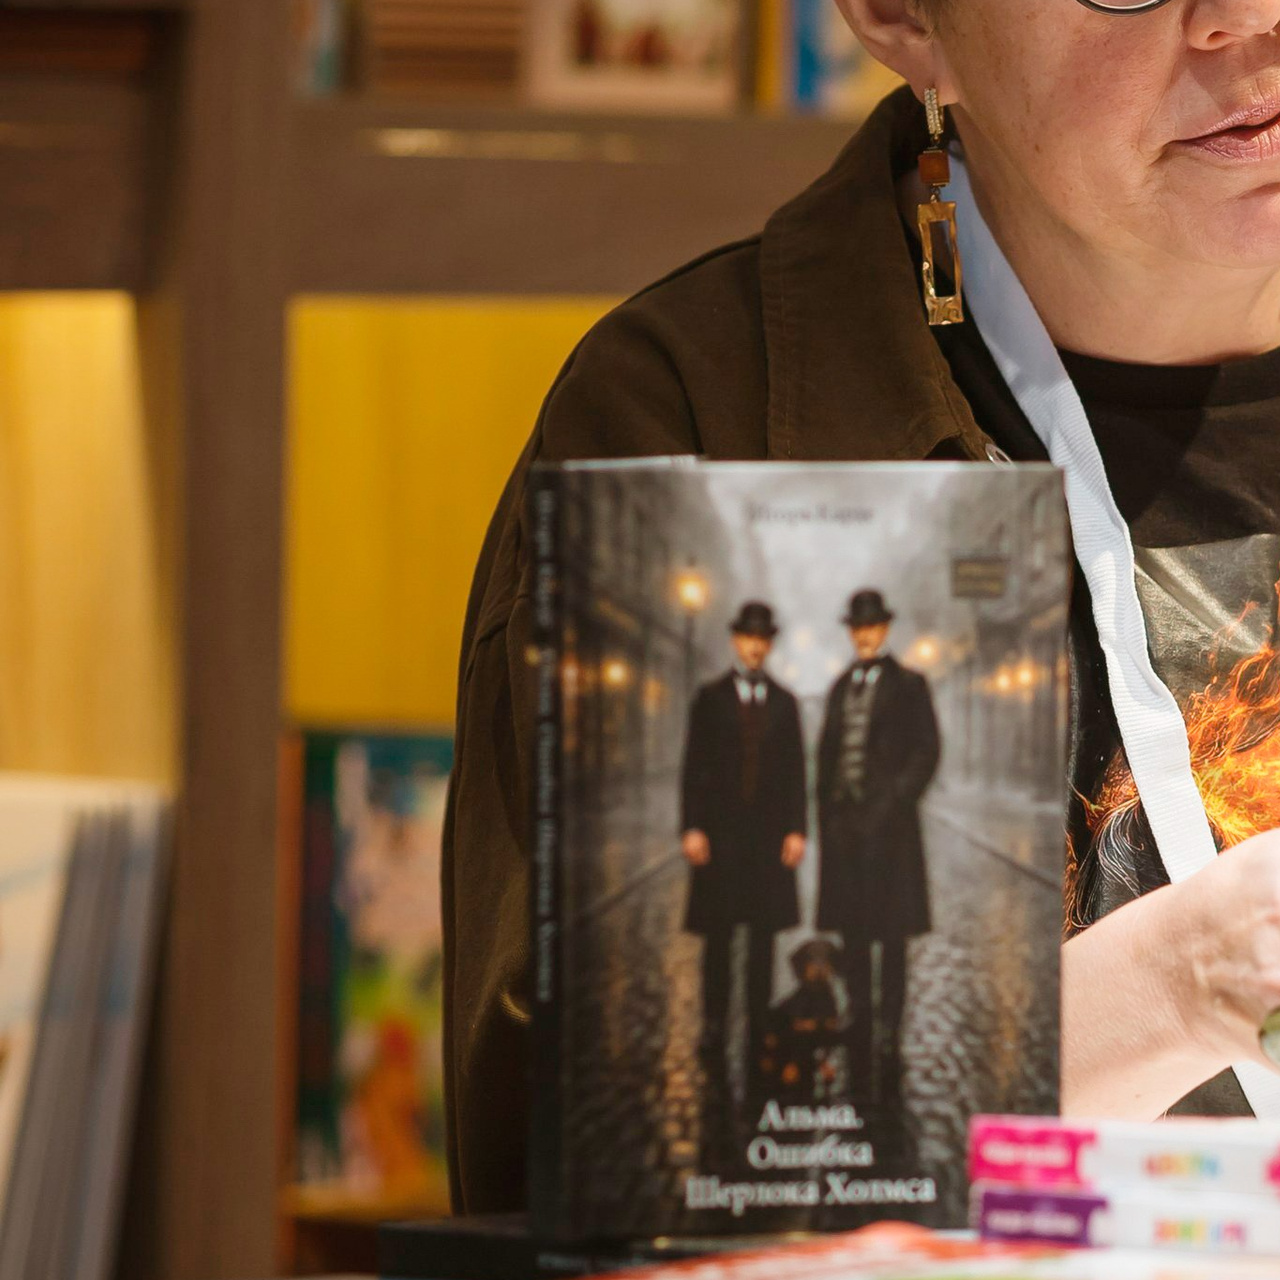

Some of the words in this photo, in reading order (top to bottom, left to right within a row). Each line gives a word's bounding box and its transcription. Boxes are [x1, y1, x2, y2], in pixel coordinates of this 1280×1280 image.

[747, 1134, 873, 1168] Ошибка
[685, 1175, 819, 1216] Шерлока
[825, 1172, 936, 1205] Холмса
